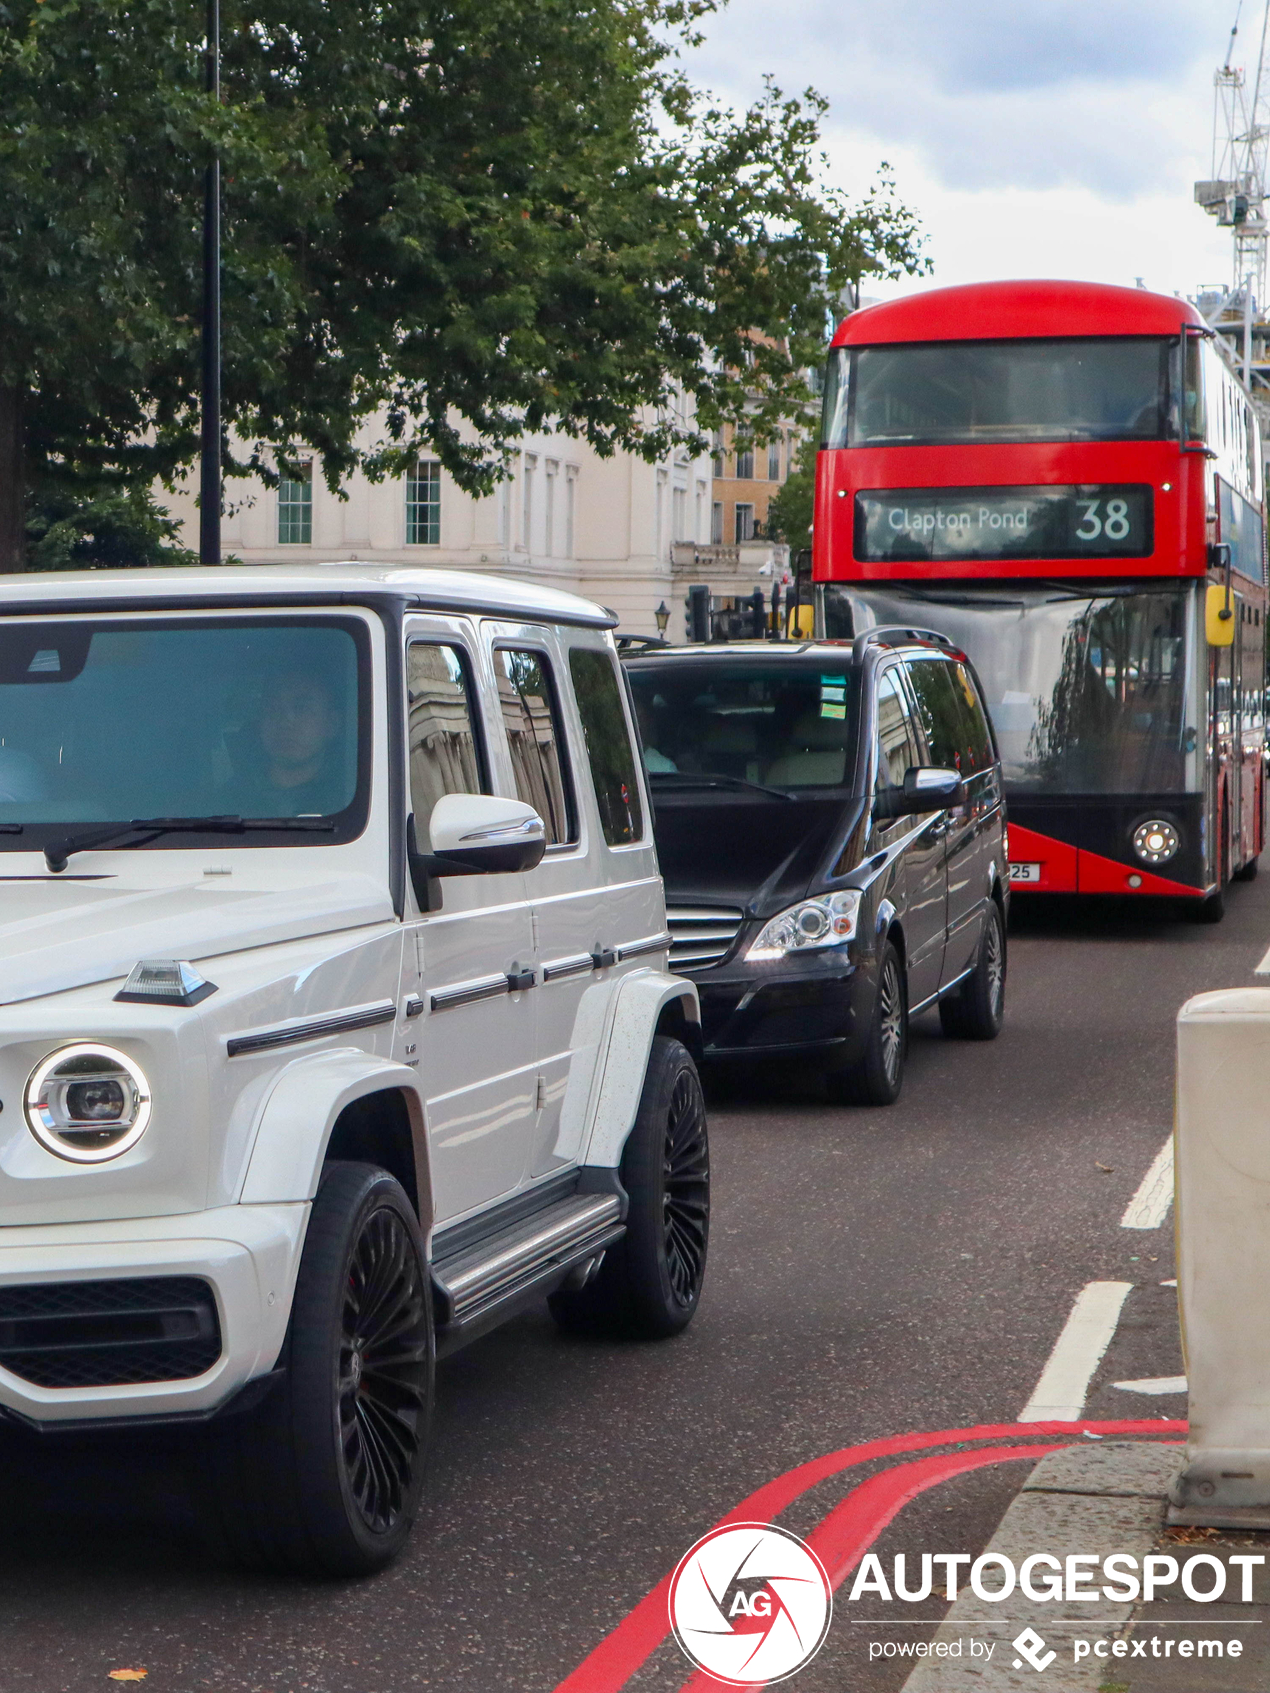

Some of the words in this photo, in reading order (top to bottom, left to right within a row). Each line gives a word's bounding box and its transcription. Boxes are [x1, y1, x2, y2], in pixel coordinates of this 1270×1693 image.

[888, 507, 971, 534] Clapton
[979, 507, 1028, 529] Pond
[1075, 499, 1130, 540] 38
